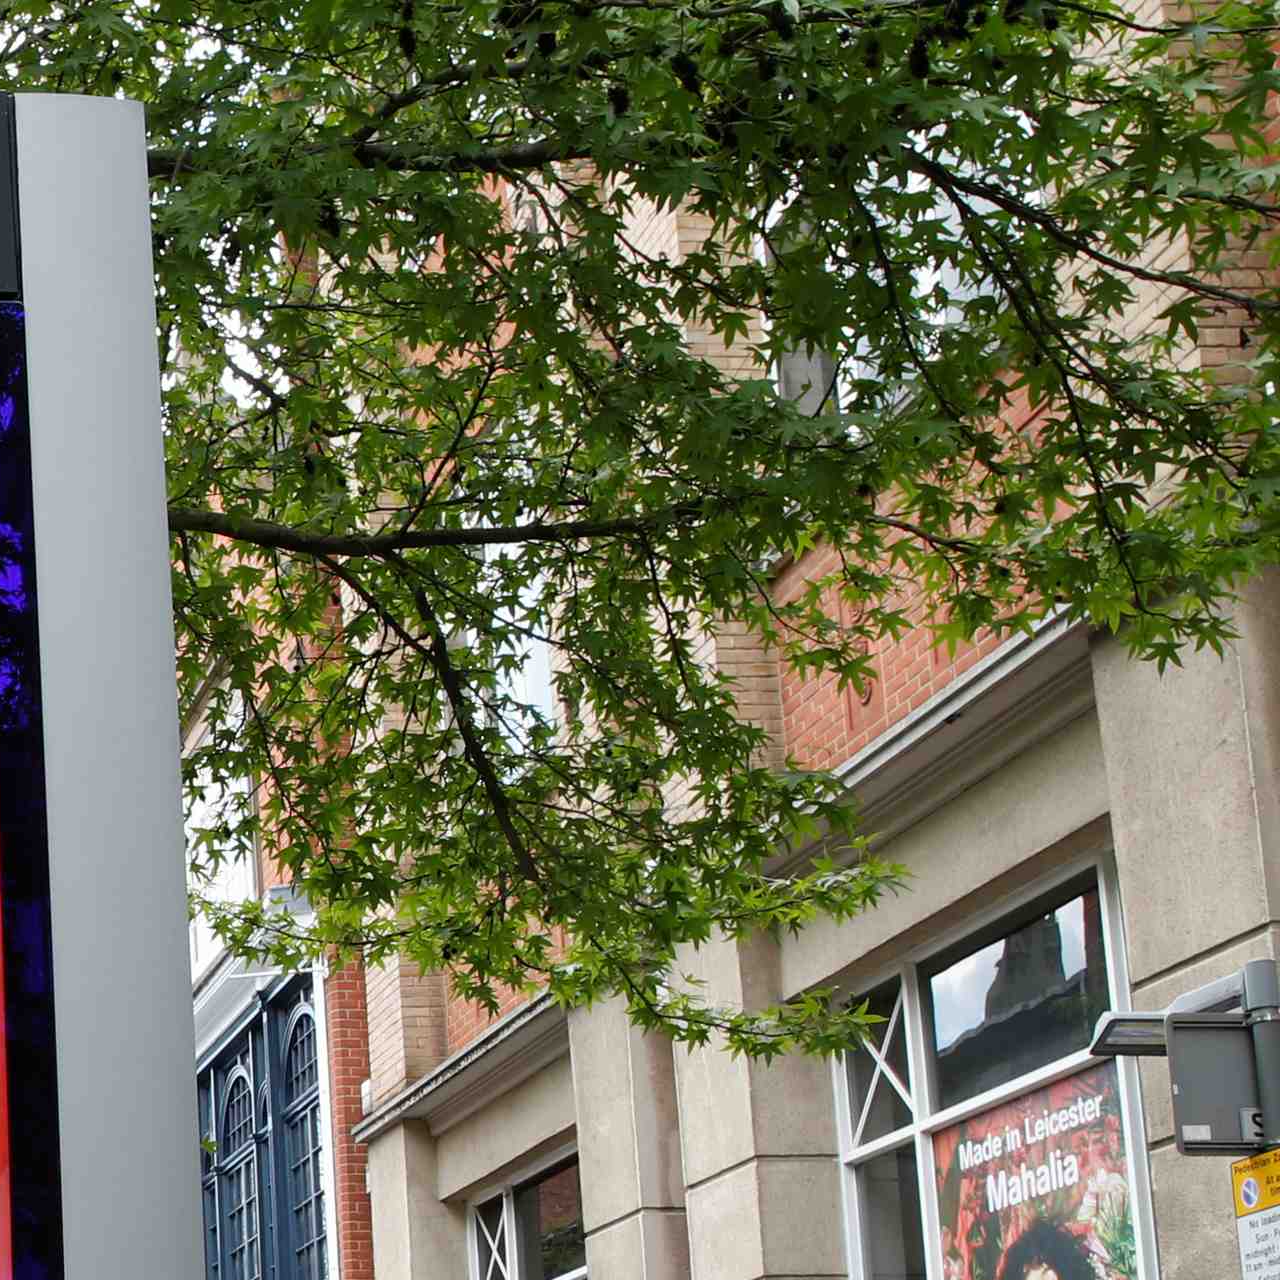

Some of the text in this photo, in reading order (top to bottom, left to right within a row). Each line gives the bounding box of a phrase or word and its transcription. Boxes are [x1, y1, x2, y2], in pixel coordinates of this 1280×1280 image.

[958, 1095, 1103, 1171] Made in Leicester
[986, 1150, 1079, 1213] Mahalia
